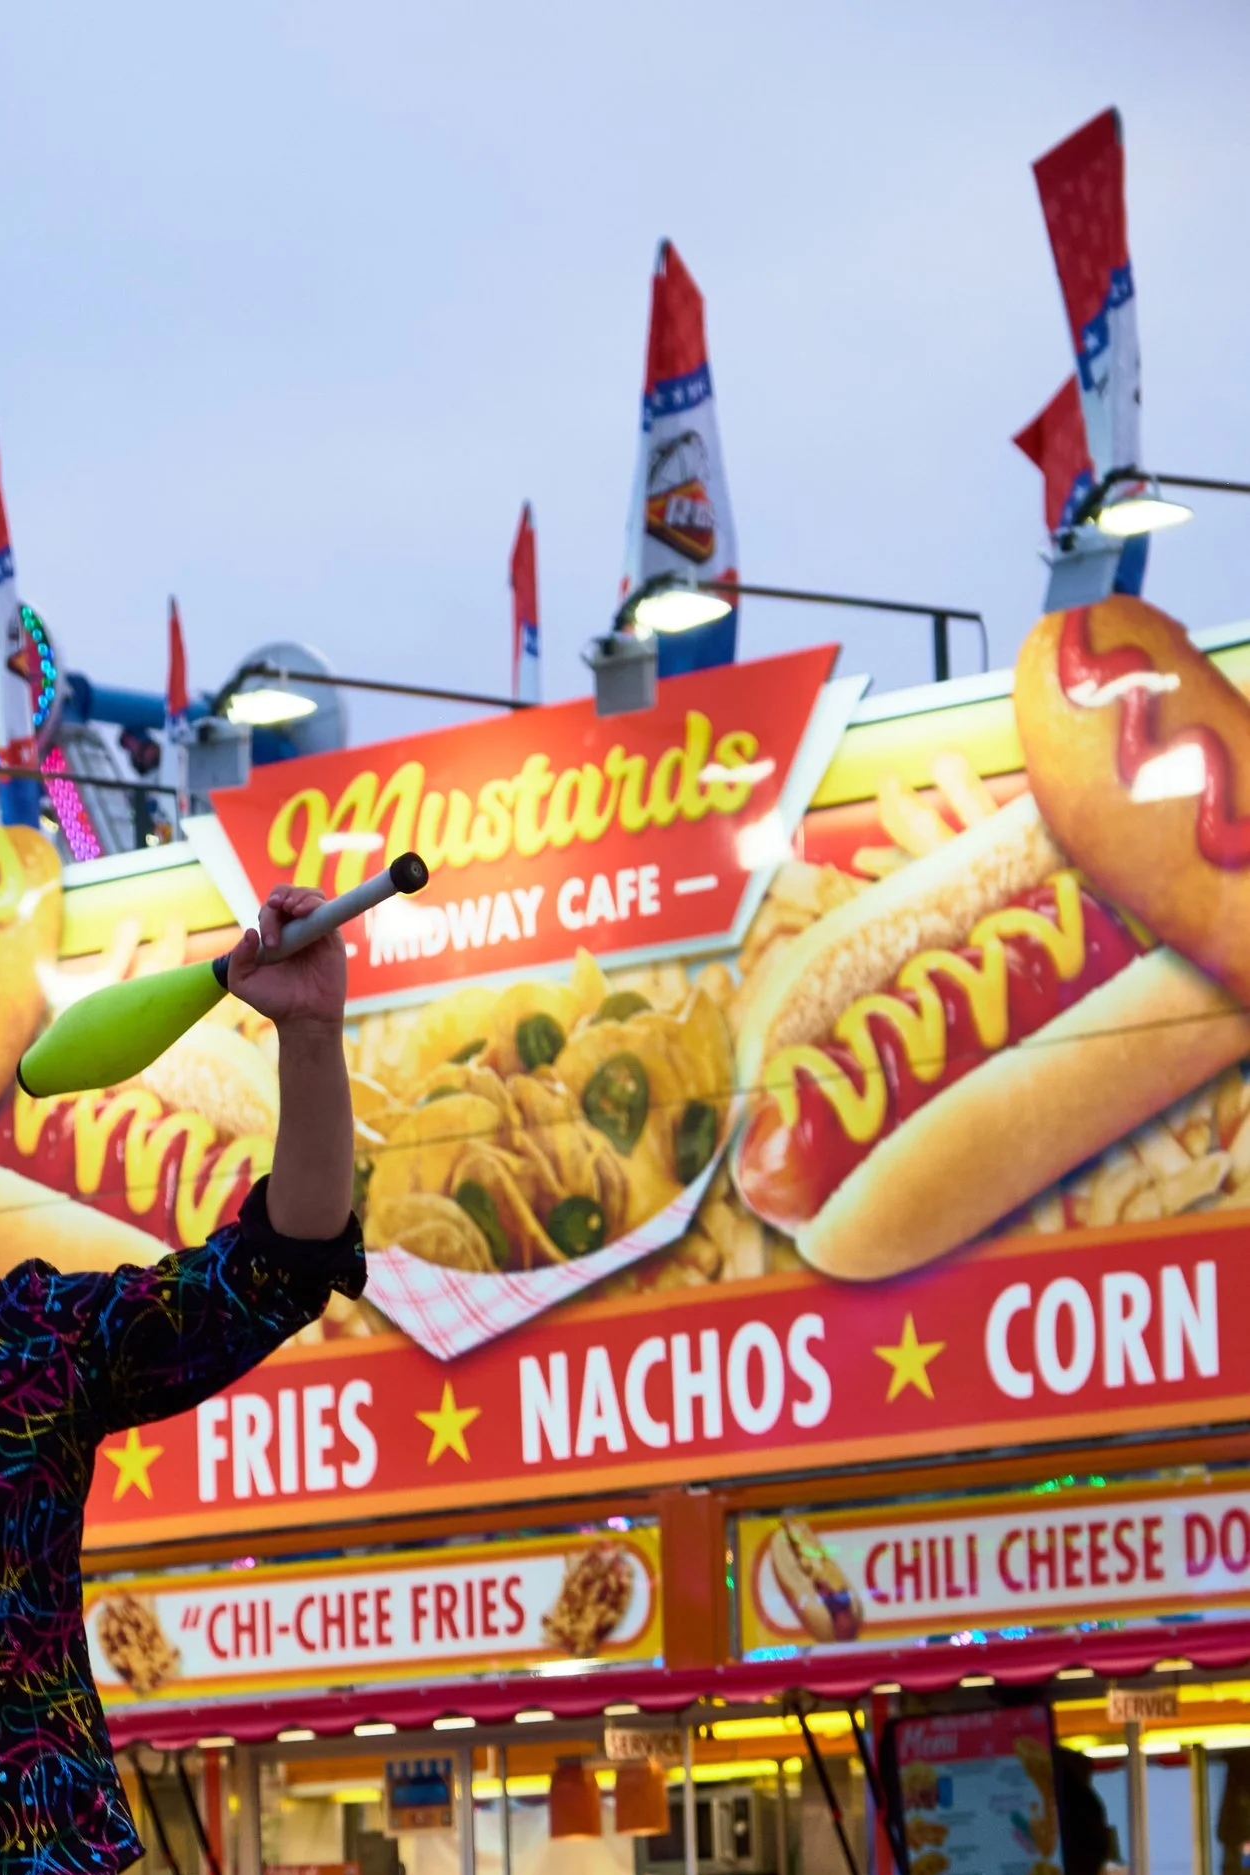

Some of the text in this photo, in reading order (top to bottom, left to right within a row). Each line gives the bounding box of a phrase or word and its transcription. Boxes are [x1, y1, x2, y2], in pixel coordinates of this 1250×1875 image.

[368, 863, 661, 967] MIDWAY CAFE
[196, 1260, 1220, 1502] FRIES NACHOS CORN
[864, 1506, 1250, 1604] CHILI CHEESE DO
[411, 1576, 526, 1645] FRIES
[611, 1732, 684, 1758] SERVICE
[1112, 1693, 1178, 1718] SERVICE
